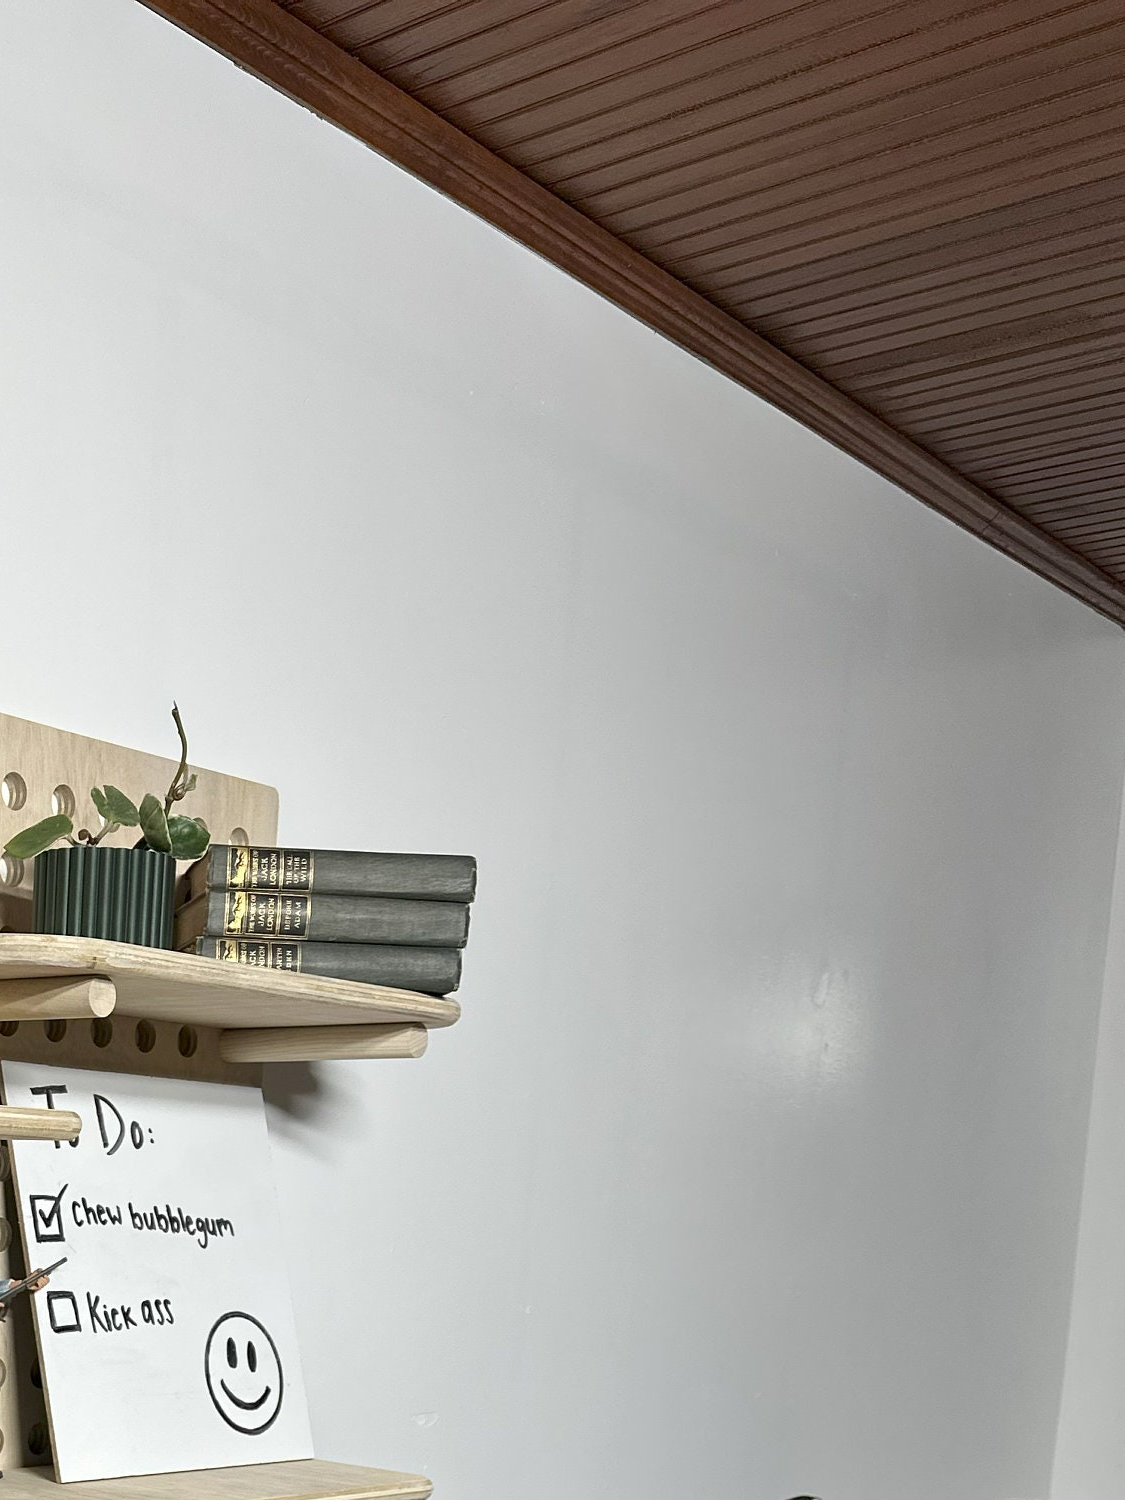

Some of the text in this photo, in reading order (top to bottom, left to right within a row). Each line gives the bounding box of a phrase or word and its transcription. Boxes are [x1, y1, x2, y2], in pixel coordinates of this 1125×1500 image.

[260, 857, 269, 881] JACK
[269, 852, 277, 886] LONDON
[293, 856, 301, 871] THE
[300, 857, 308, 882] WILD
[257, 902, 266, 927] JACK
[266, 897, 276, 931] LONDON
[293, 901, 302, 929] ADAM
[127, 1202, 235, 1249] bubblegum
[86, 1291, 175, 1334] Kick ass
